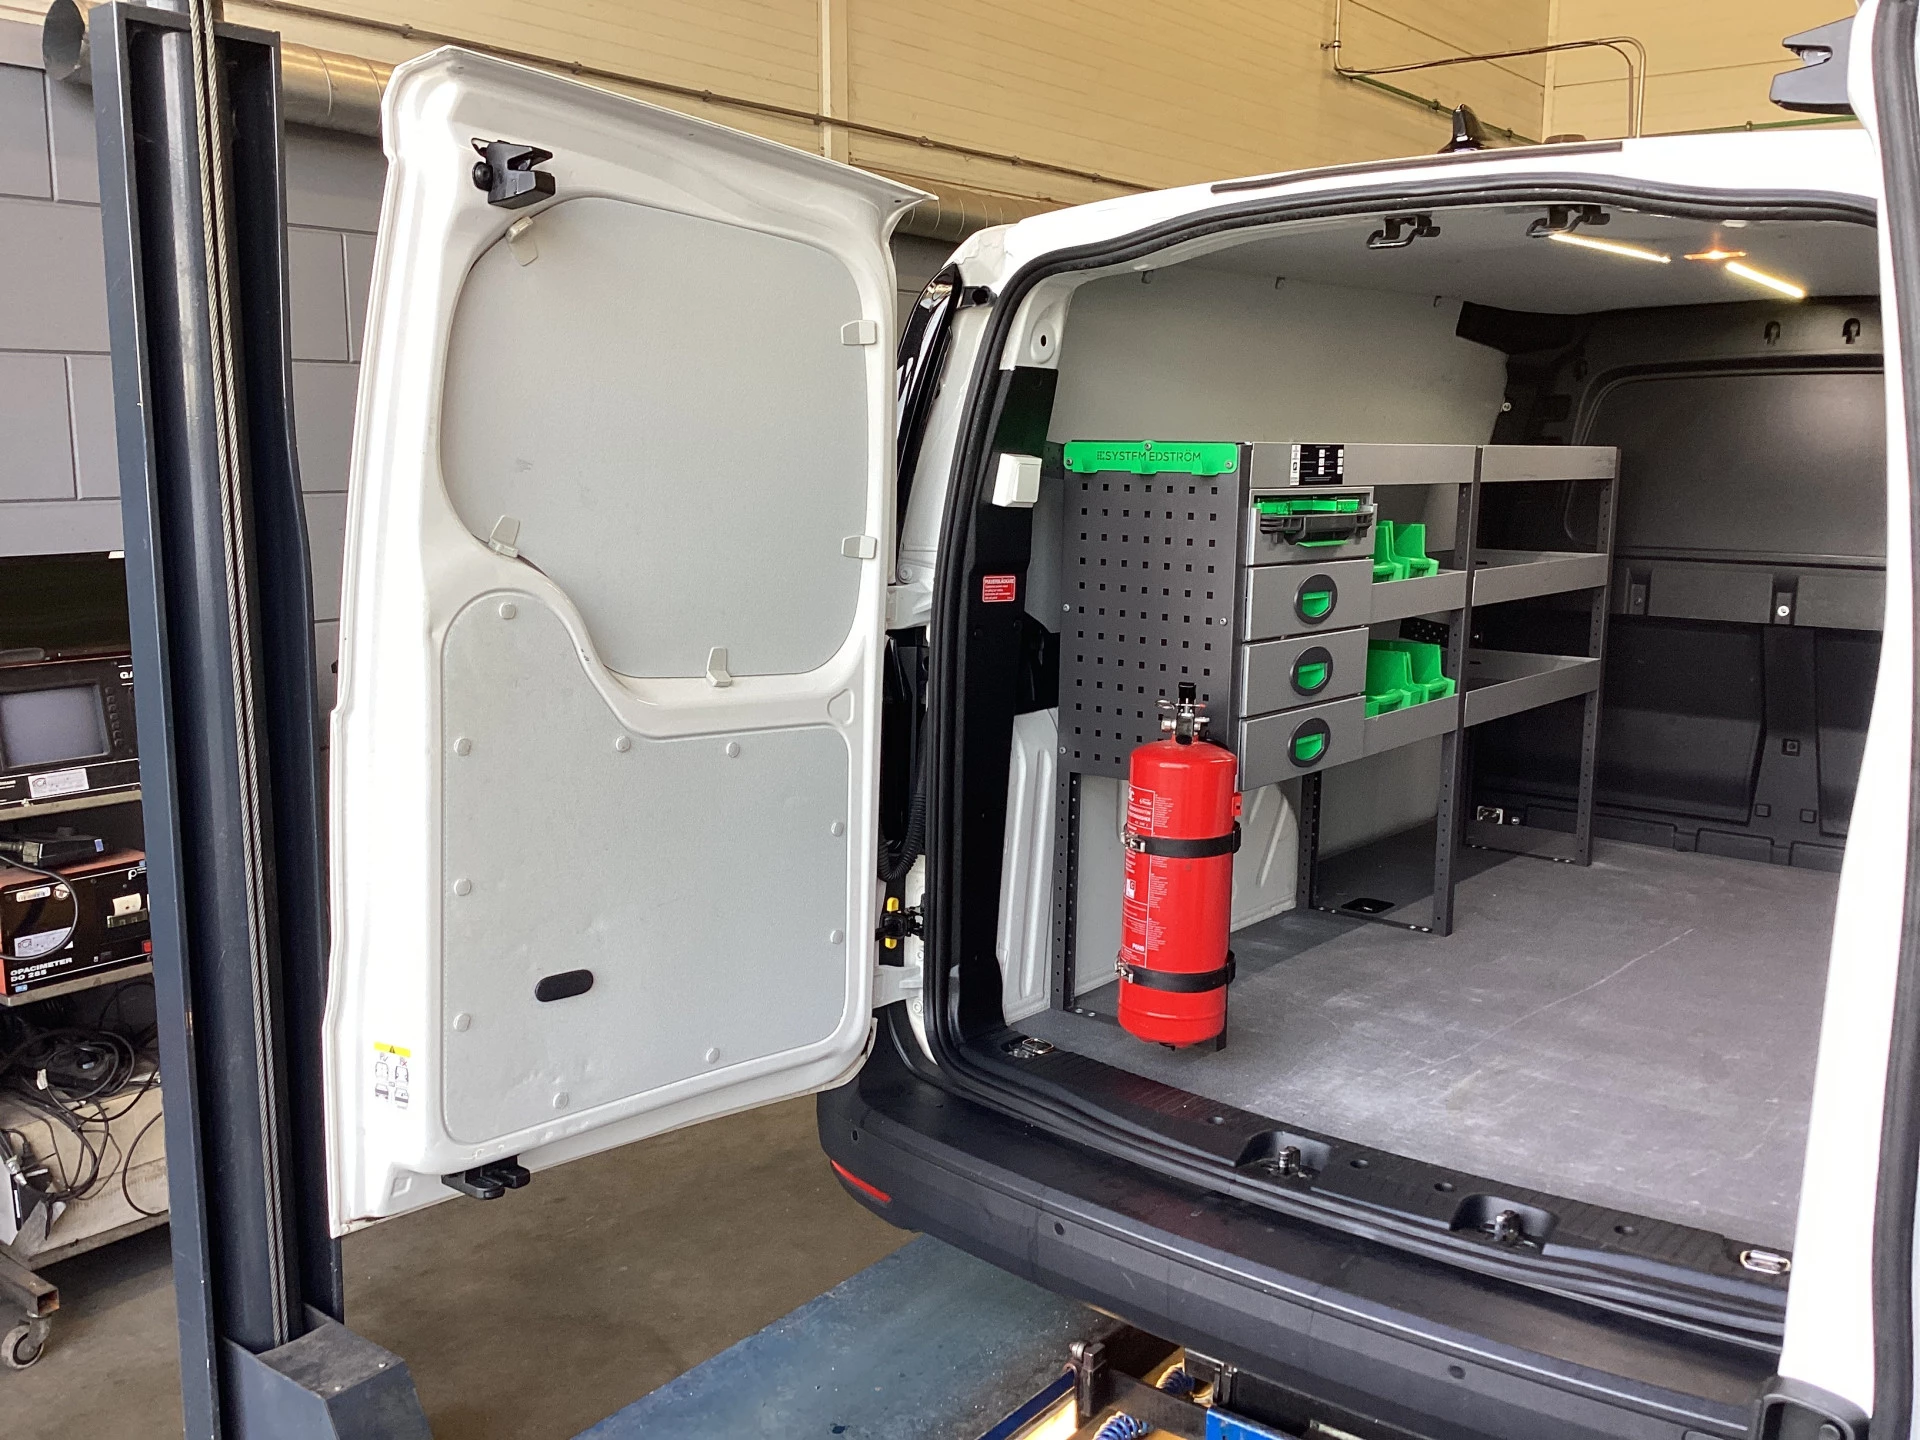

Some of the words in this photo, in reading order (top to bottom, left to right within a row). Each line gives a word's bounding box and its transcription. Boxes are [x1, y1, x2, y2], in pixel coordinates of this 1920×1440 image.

[1149, 449, 1201, 462] EDSTRÖM
[10, 957, 73, 976] OPACIMETER
[10, 974, 26, 983] DO
